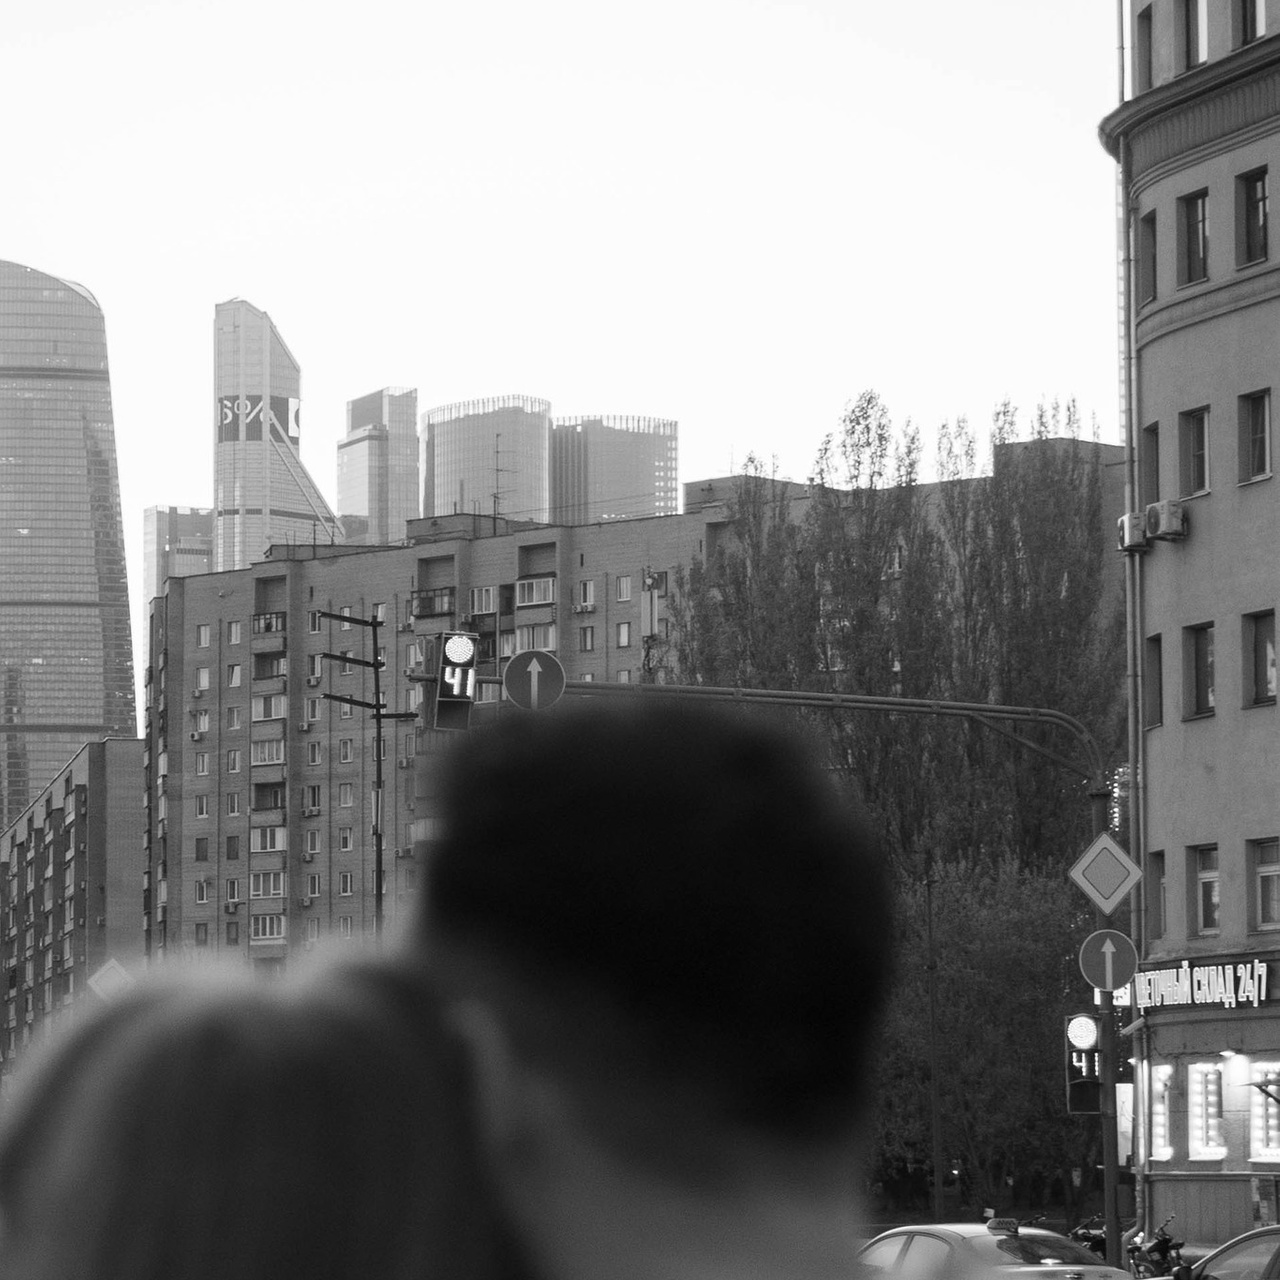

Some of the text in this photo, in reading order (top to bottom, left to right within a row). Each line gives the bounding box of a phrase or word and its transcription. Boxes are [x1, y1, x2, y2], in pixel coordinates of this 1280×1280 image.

[445, 667, 475, 697] 41
[1135, 959, 1267, 1016] ЦВЕТОЧНЫЙ СКЛАД 24/7
[1072, 1052, 1099, 1077] 41
